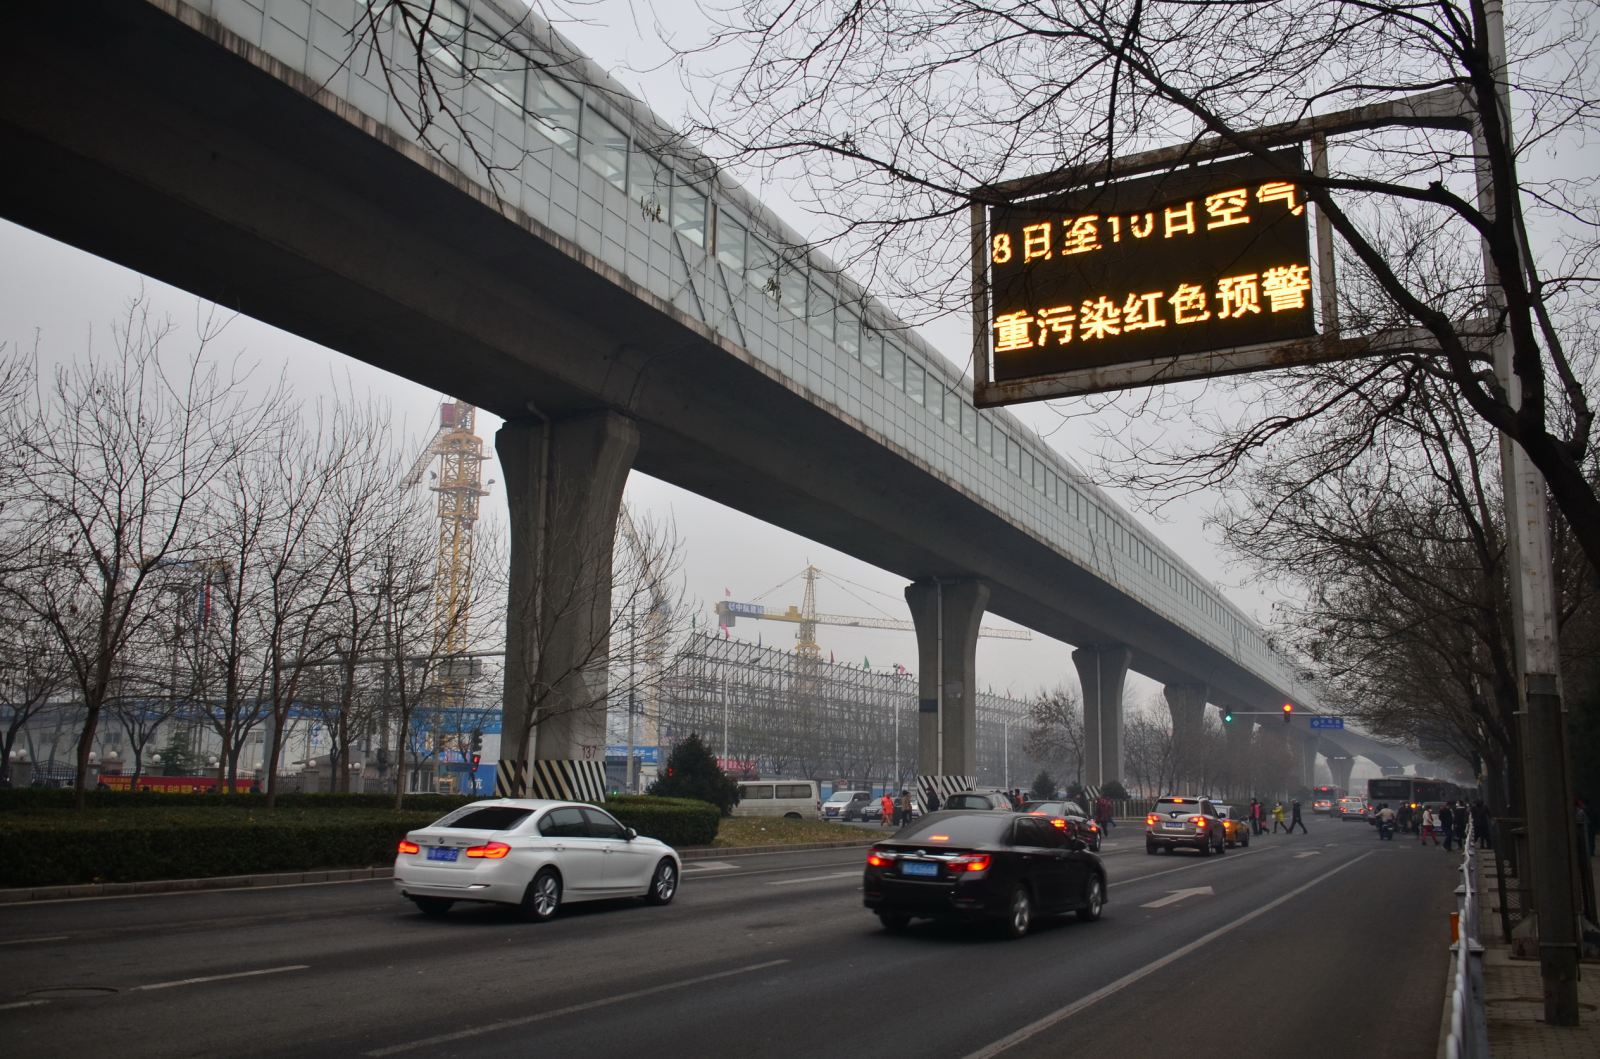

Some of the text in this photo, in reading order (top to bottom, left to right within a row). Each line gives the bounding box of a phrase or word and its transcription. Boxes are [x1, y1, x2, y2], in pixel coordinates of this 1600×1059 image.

[992, 181, 1304, 264] 8日至10日空气
[992, 264, 1310, 352] 重污染红色预警
[582, 744, 597, 759] 137
